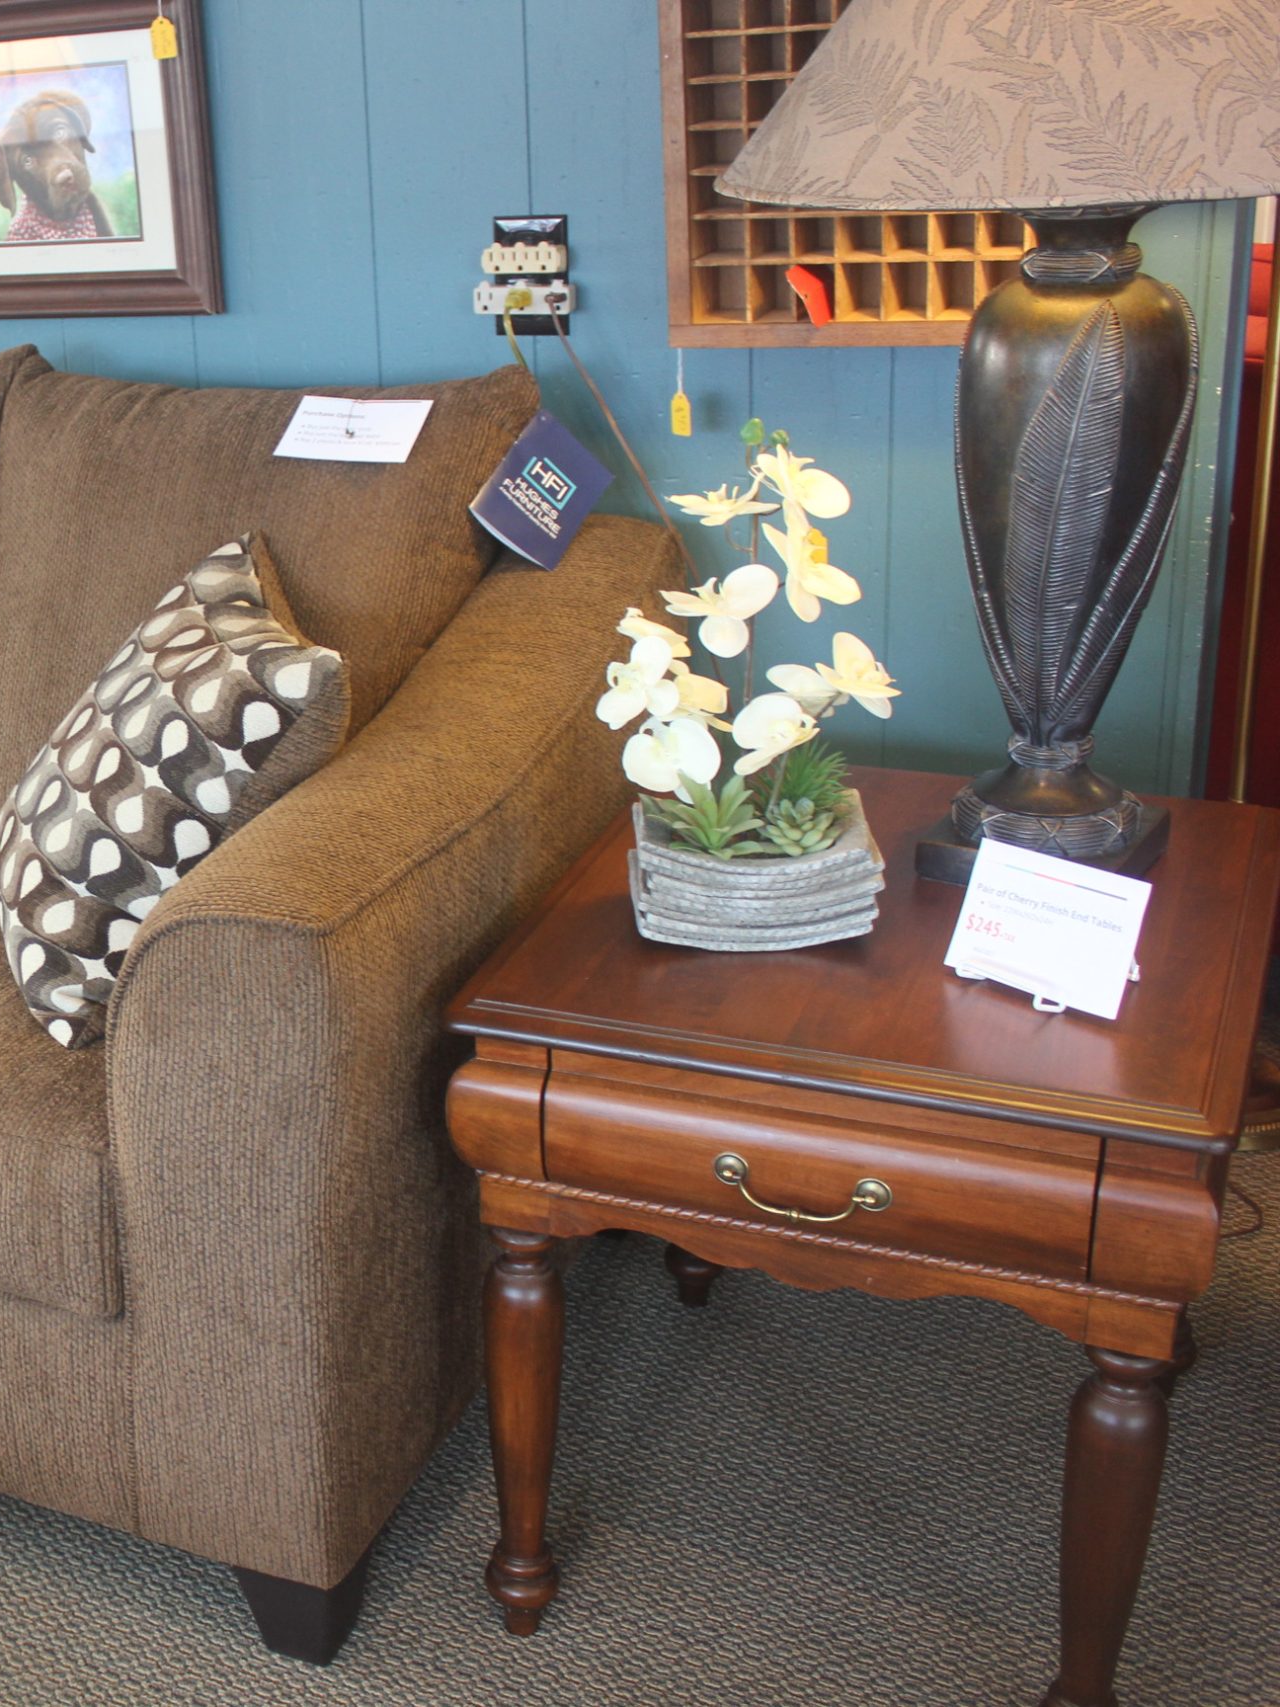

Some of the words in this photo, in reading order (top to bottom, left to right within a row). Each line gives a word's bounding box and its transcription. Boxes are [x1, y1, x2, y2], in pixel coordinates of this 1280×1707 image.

[515, 477, 559, 520] HUGHES
[531, 461, 569, 500] HFI
[502, 478, 561, 534] FURNITURE
[977, 883, 994, 895] Pair
[996, 889, 1007, 897] of
[1008, 892, 1039, 909] Cherry
[1041, 901, 1069, 916] Finish
[1071, 909, 1090, 923] End
[1092, 916, 1122, 933] Tables
